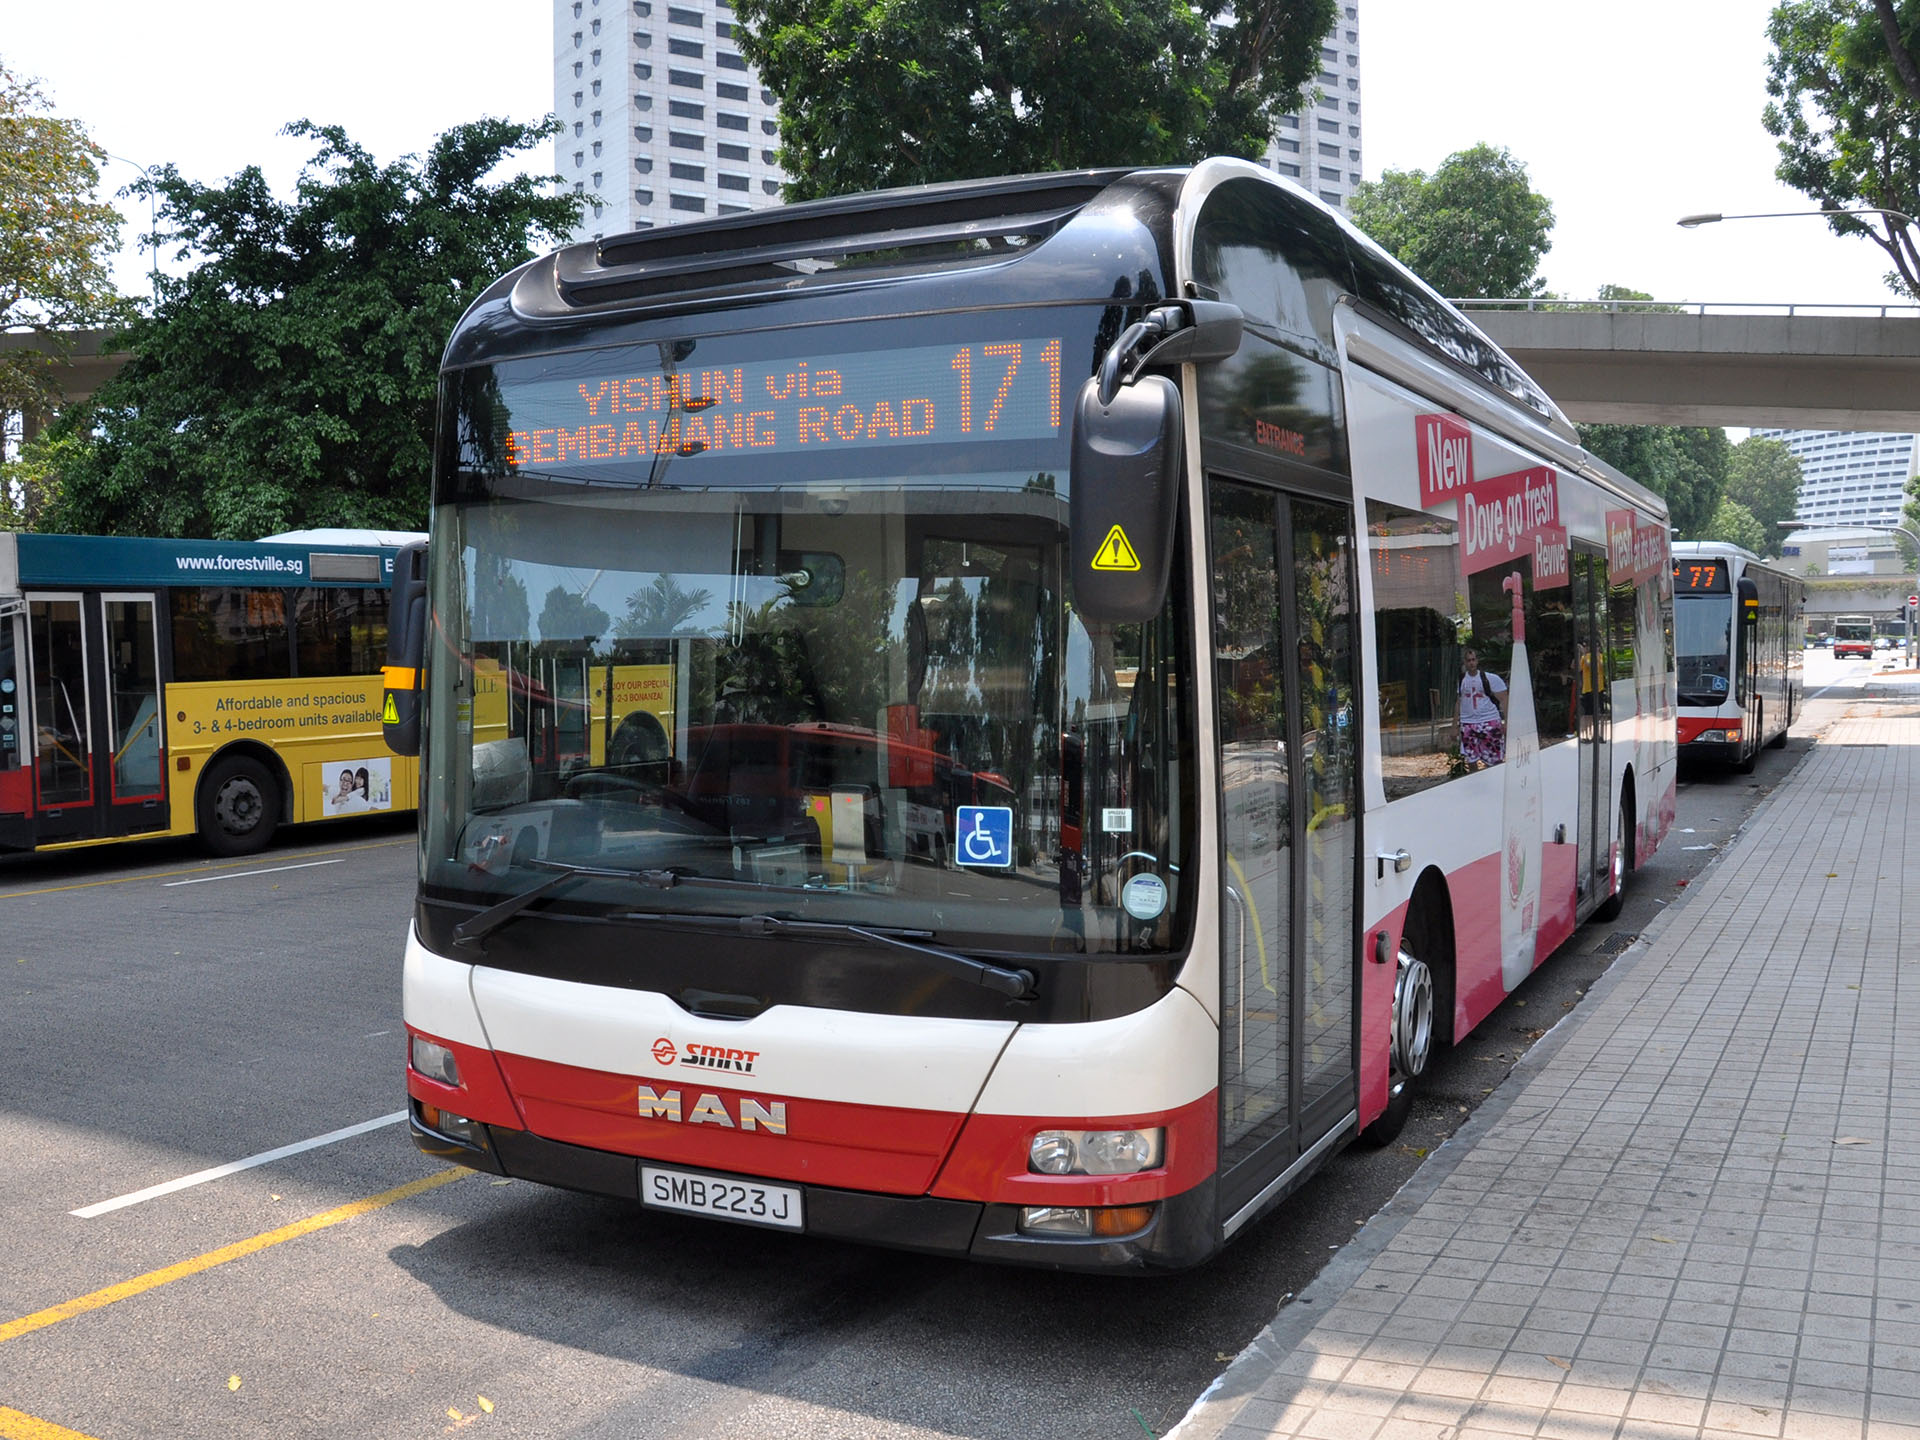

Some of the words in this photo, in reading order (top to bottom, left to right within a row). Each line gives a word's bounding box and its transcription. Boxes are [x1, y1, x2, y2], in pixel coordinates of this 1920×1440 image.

[579, 368, 743, 416] YISHUN
[765, 362, 842, 399] via
[952, 340, 1060, 432] 171
[505, 410, 776, 465] SEMBAWANG
[799, 399, 935, 443] ROAD
[1256, 419, 1305, 457] ENTRANCE
[1427, 422, 1468, 493] New
[1464, 492, 1504, 556] Dove
[1506, 493, 1523, 553] go
[1525, 471, 1555, 531] fresh
[176, 554, 304, 575] www.forestville.sg
[1535, 533, 1566, 579] Revive
[1611, 515, 1634, 574] fresh
[1690, 566, 1716, 588] 77
[216, 695, 283, 712] Affordable
[287, 694, 310, 708] and
[313, 692, 366, 709] spacious
[602, 681, 626, 692] EJOY
[627, 680, 642, 691] OUR
[643, 679, 670, 690] SPECIAL
[193, 720, 207, 735] 3-
[211, 719, 221, 733] &
[224, 716, 295, 732] 4-bedroom
[299, 712, 328, 727] units
[331, 709, 382, 725] available
[681, 1043, 760, 1073] SMRT
[638, 1085, 788, 1136] MAN
[654, 1174, 789, 1220] SMB223J
